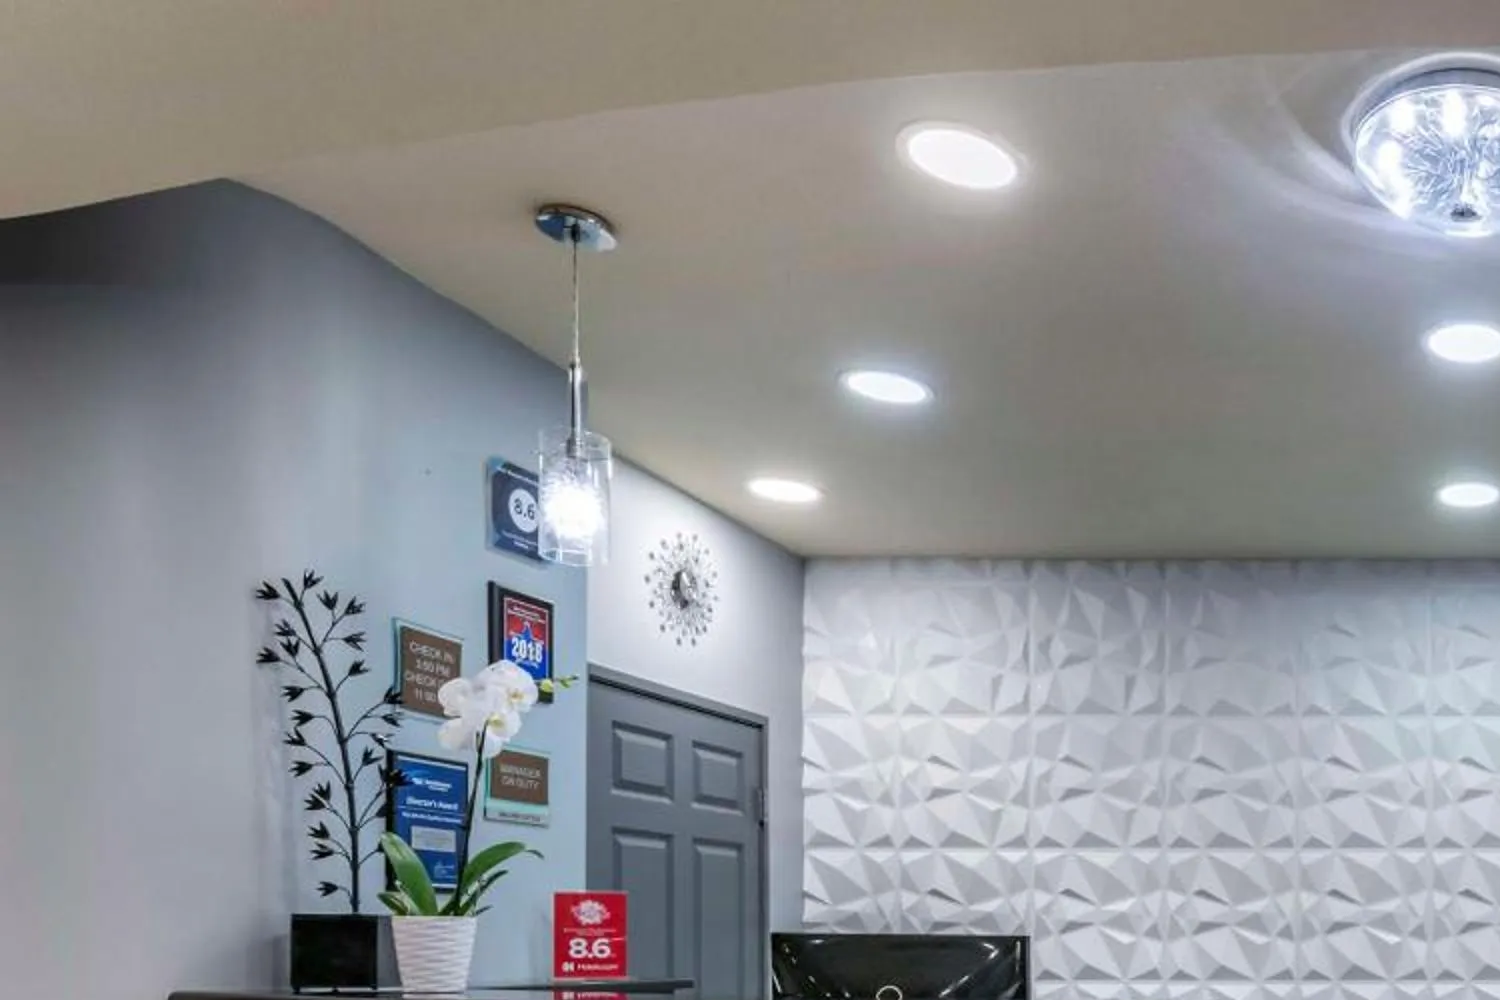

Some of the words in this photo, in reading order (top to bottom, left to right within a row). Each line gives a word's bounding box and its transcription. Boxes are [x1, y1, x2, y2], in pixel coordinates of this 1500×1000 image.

[513, 498, 537, 521] 8.6
[409, 641, 442, 659] CHECK
[511, 636, 544, 663] 2018
[568, 938, 612, 959] 8.6
